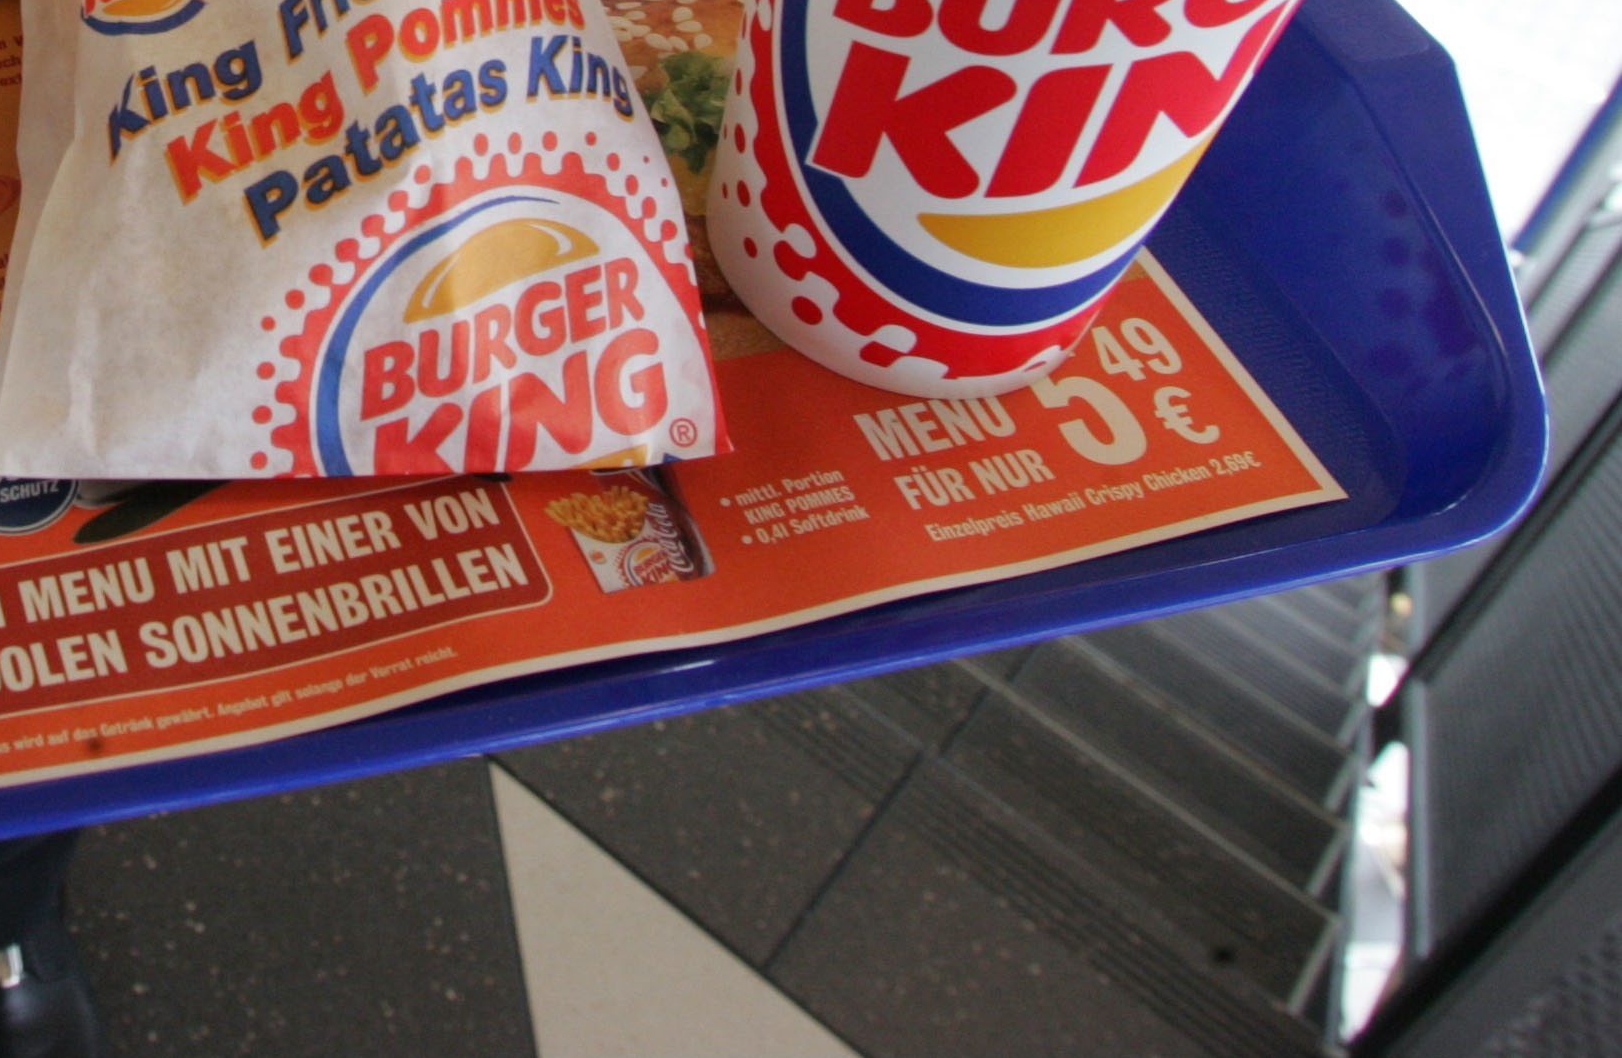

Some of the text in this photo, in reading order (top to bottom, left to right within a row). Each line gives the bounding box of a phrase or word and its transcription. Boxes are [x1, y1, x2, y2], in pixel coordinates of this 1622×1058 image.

[108, 39, 264, 164] King
[164, 70, 345, 205] King
[243, 34, 636, 249] Patatas King
[361, 257, 645, 421] BURGER
[1091, 315, 1183, 382] 49
[373, 328, 669, 475] KING
[1028, 373, 1149, 466] 5
[1153, 385, 1221, 445] €
[0, 479, 60, 504] SCHUTZ
[735, 469, 846, 507] mittl. Portion
[743, 485, 857, 525] KING POMMES
[788, 503, 871, 535] Softdrink
[893, 448, 1057, 511] FÜR NUR
[924, 449, 1264, 542] Einzelpreis Hawaii Crispy Chicken 2,69€
[17, 556, 156, 624] MENU
[165, 536, 252, 595] MIT
[263, 509, 402, 575] EINER
[403, 487, 500, 542] VON
[139, 542, 529, 670] SONNENBRILLEN
[13, 733, 45, 750] wird
[47, 729, 70, 746] auf
[73, 725, 99, 742] das
[100, 715, 154, 740] Getränk
[216, 694, 269, 718] Angebot
[294, 679, 344, 701] solange
[345, 670, 368, 687] der
